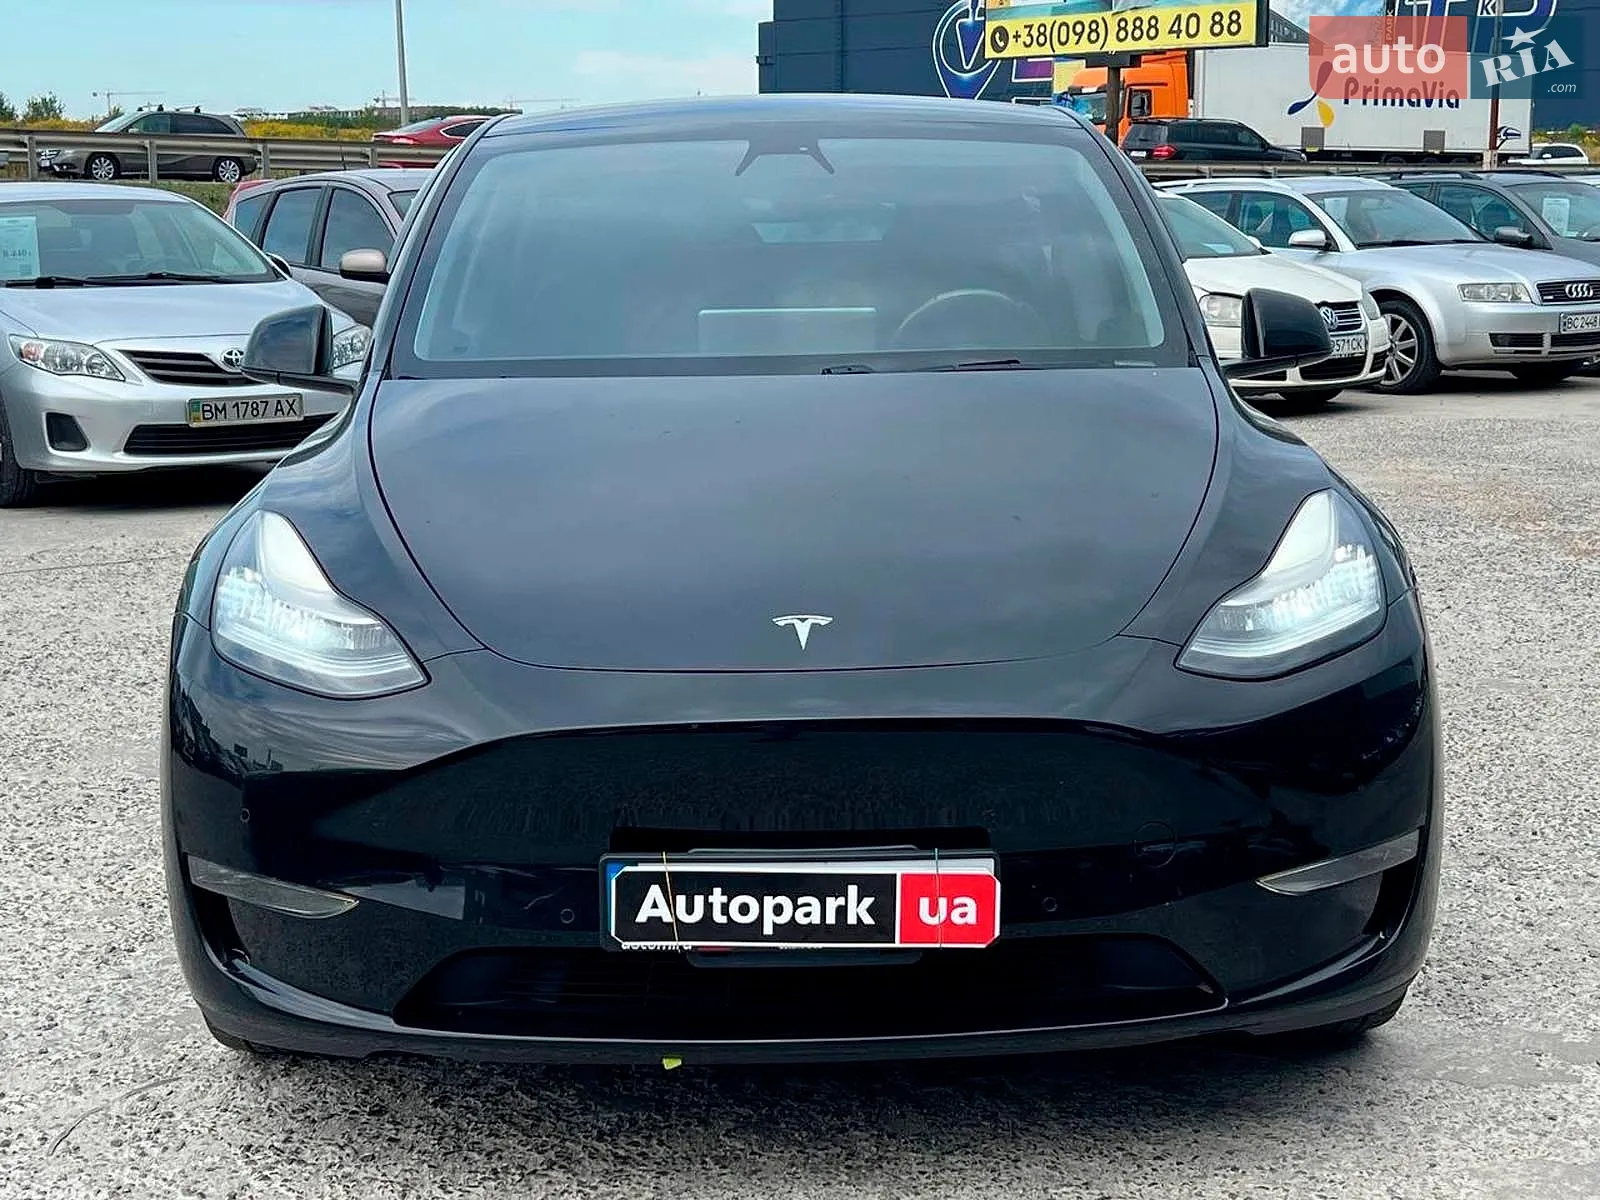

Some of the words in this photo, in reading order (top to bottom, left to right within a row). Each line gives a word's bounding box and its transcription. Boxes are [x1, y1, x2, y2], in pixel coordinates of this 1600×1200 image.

[1012, 17, 1109, 52] +38(098)
[1116, 15, 1160, 43] 888
[1168, 12, 1201, 39] 40
[1209, 9, 1242, 37] 88
[1343, 77, 1460, 109] PrimaVia
[201, 403, 227, 420] BM
[232, 400, 269, 418] 1787
[274, 399, 297, 416] AX
[635, 884, 876, 935] Autopark
[918, 896, 978, 925] ua
